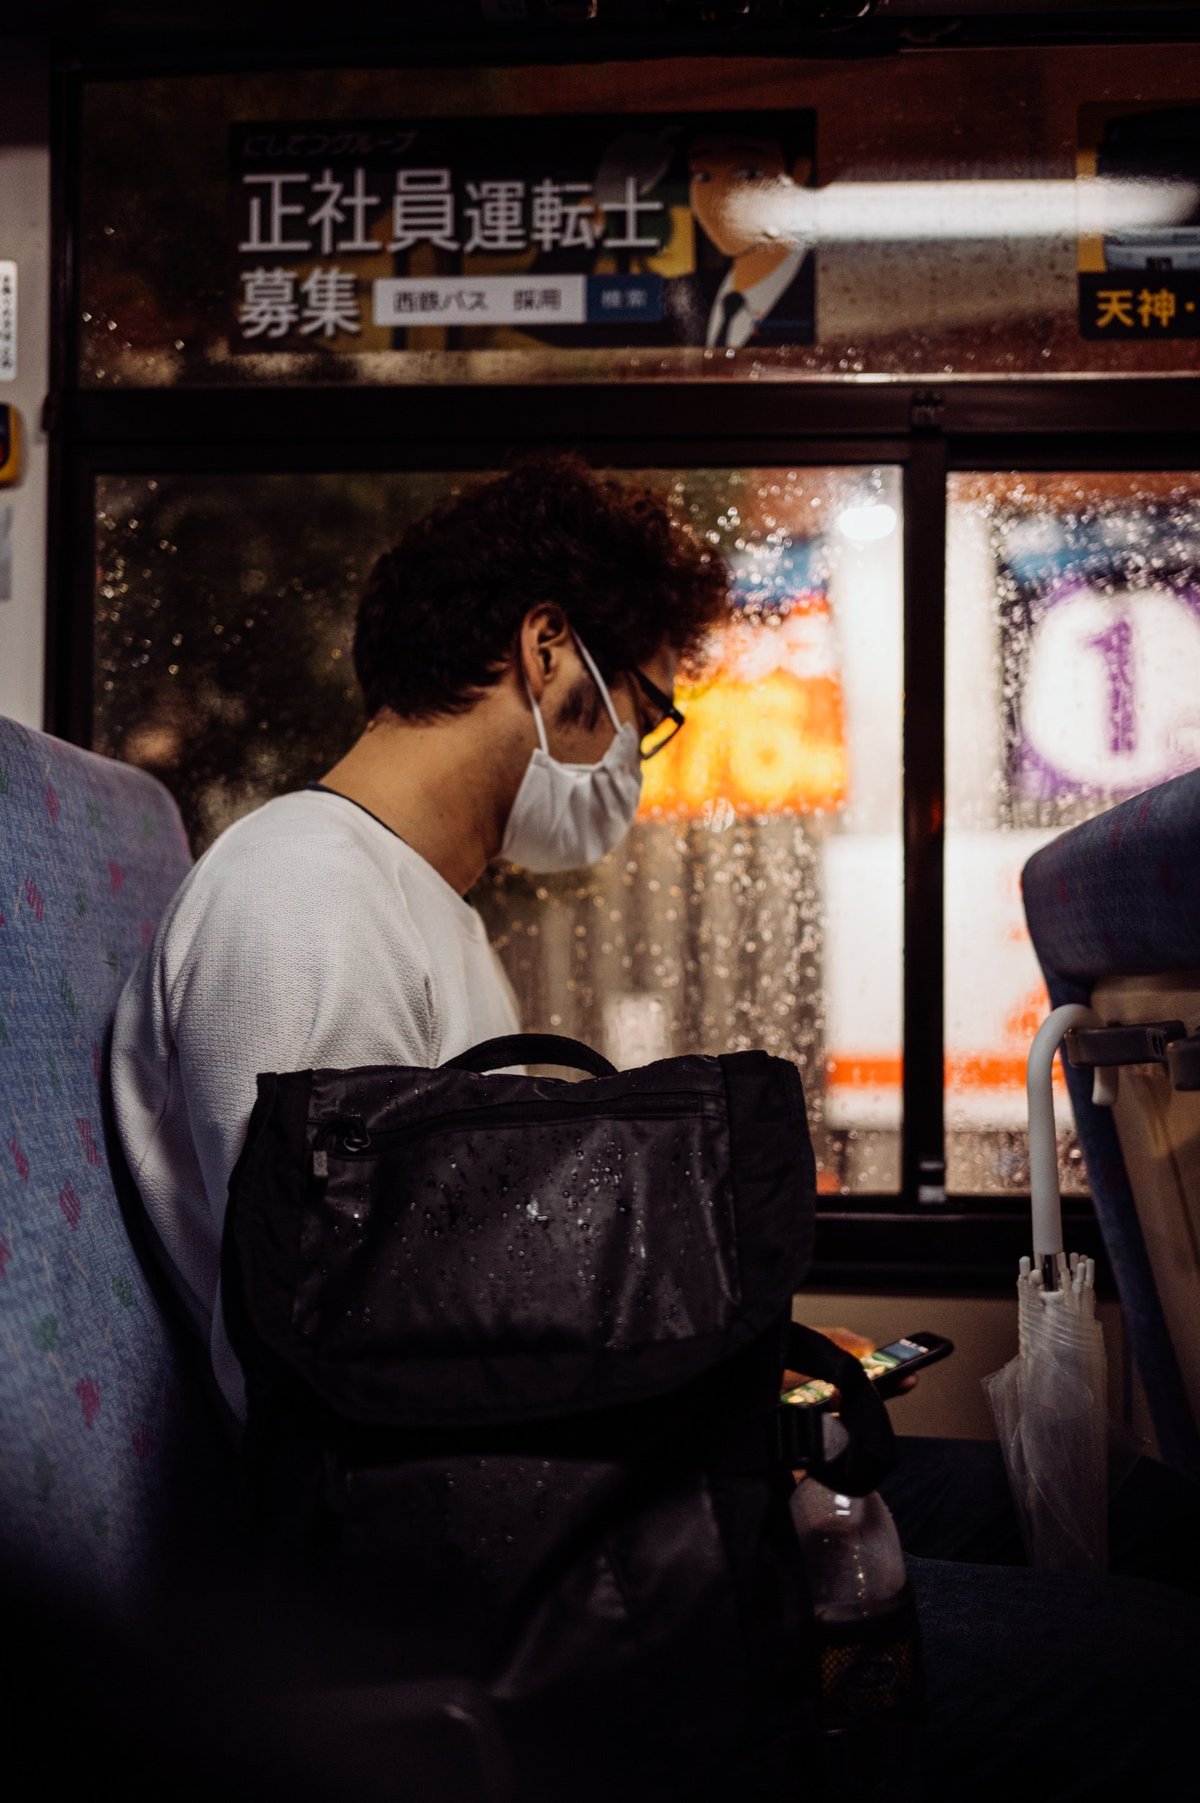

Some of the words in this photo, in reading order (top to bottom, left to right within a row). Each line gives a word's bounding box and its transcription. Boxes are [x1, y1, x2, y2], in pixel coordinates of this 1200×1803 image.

[238, 168, 663, 255] 正社員運転士
[238, 266, 361, 338] 募集
[393, 289, 488, 313] 西鉄バス
[513, 288, 562, 311] 採用
